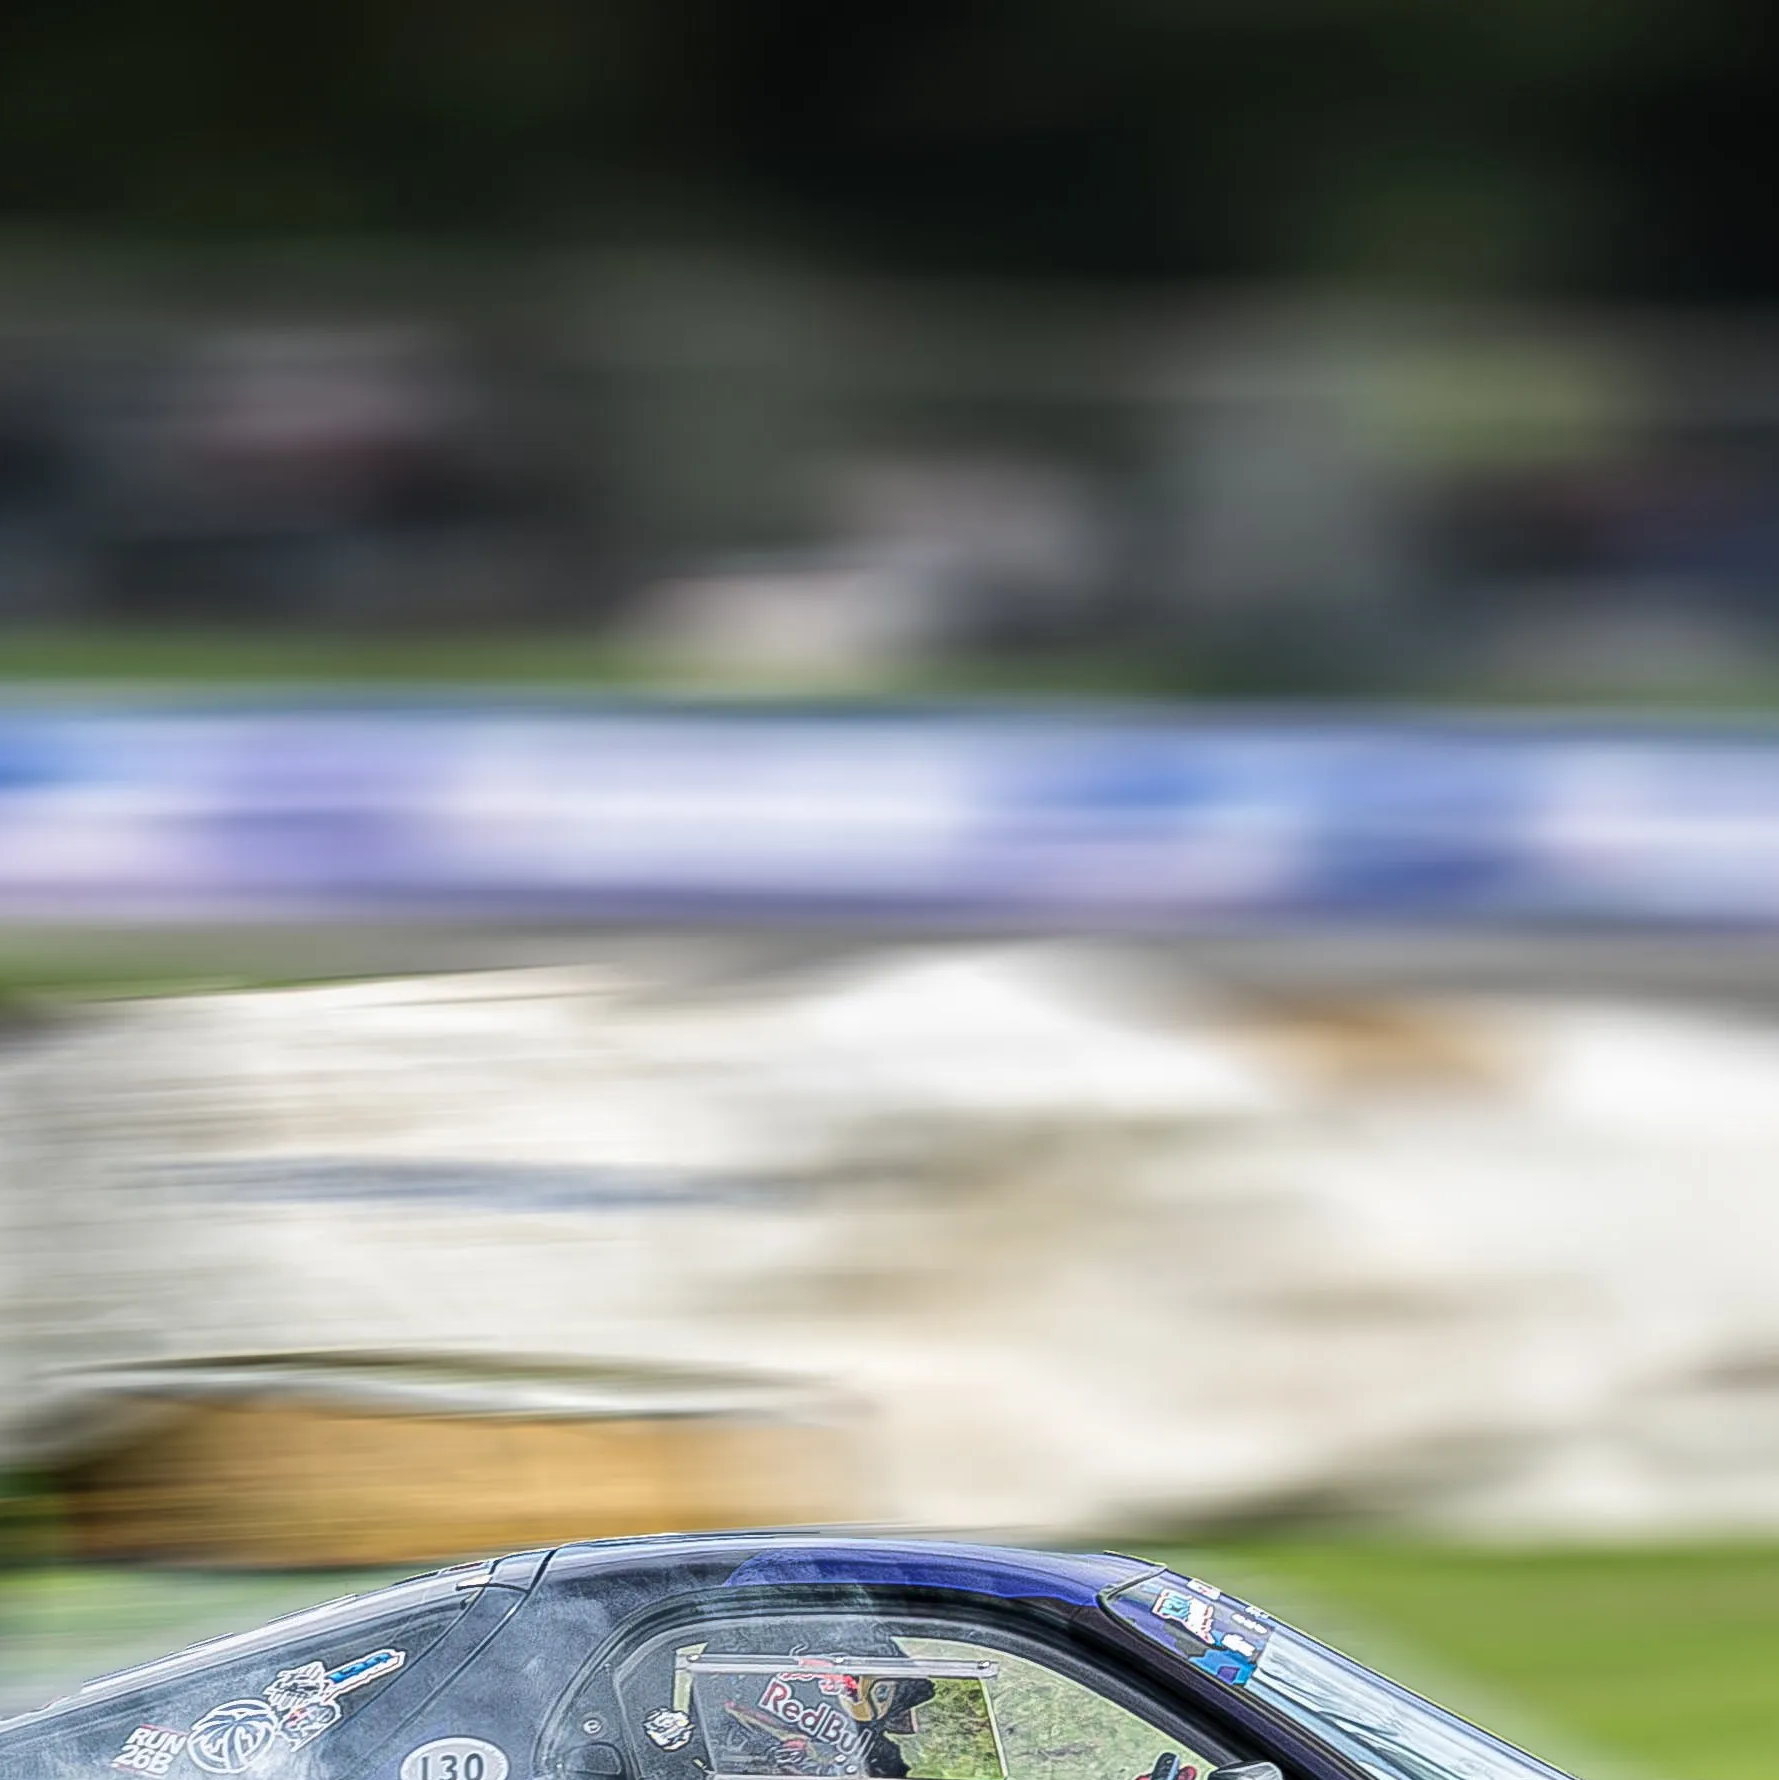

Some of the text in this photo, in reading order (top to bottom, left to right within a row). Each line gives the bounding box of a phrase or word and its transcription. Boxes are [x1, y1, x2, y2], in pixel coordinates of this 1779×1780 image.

[758, 1678, 825, 1737] Red
[126, 1727, 187, 1755] RUN
[112, 1746, 171, 1774] 26B
